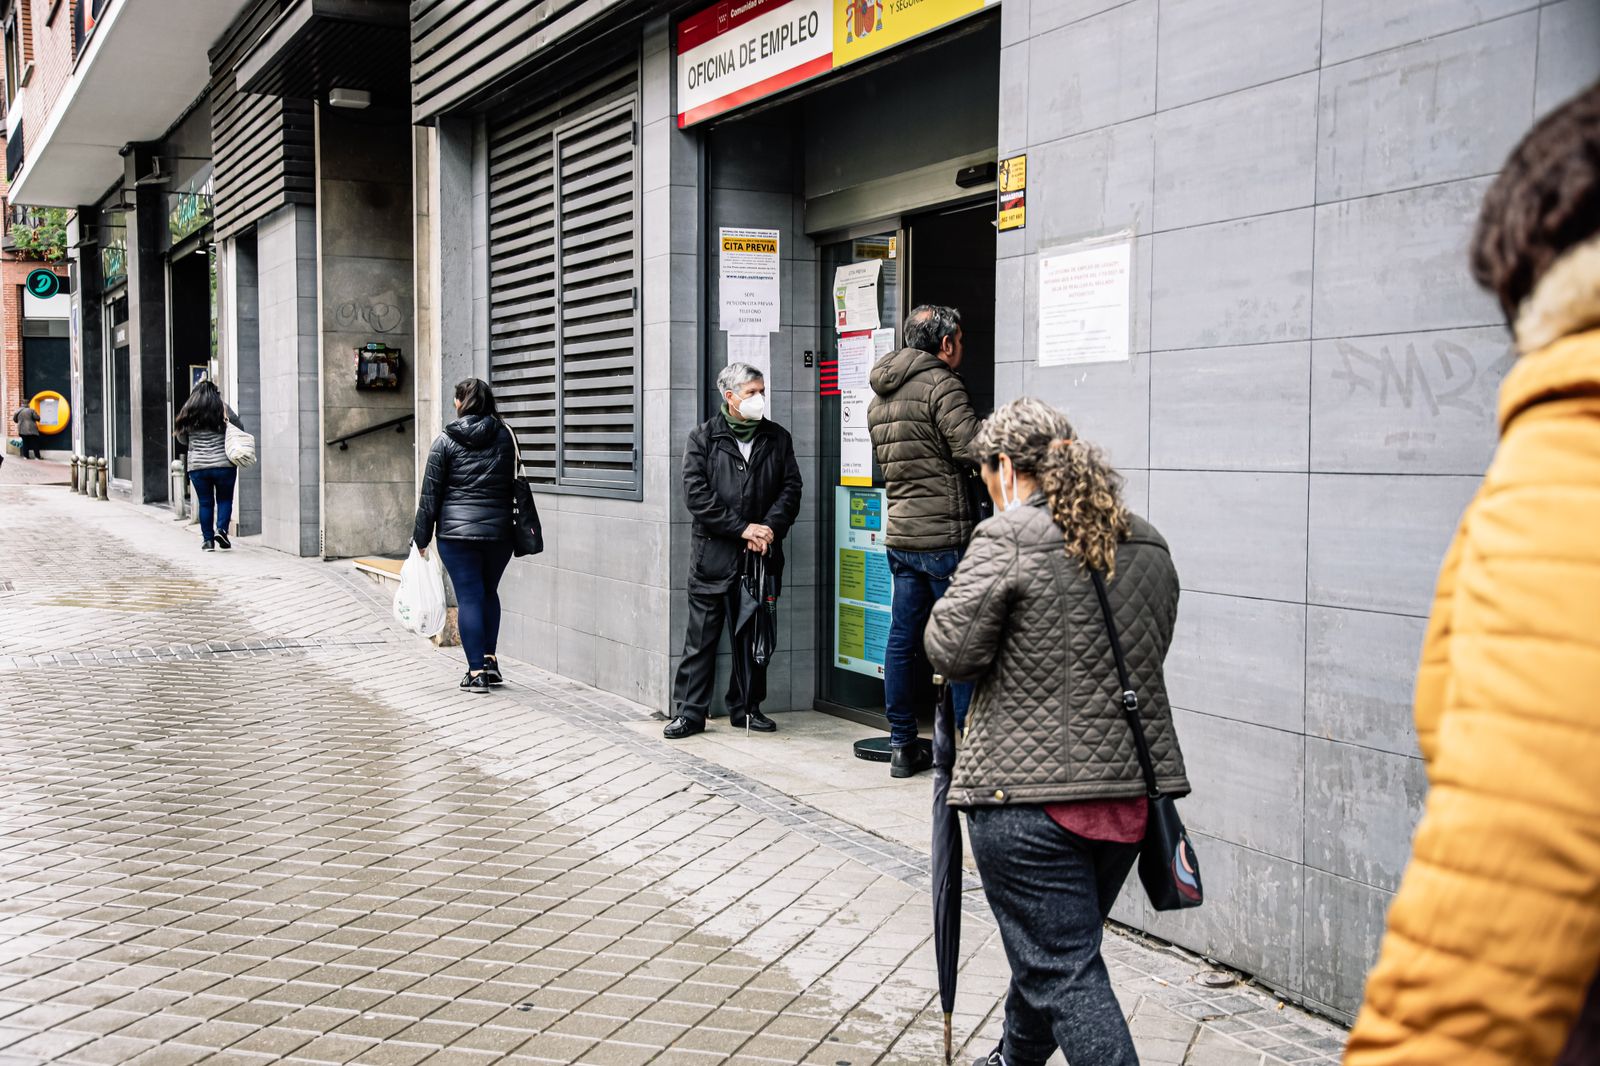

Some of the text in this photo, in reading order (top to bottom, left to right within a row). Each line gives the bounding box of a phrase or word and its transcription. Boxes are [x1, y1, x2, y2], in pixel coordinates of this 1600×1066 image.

[731, 0, 757, 18] Comunidad
[890, 3, 894, 15] Y
[688, 10, 819, 90] OFICINA DE EMPLEO
[724, 242, 776, 252] CITA PREVIA
